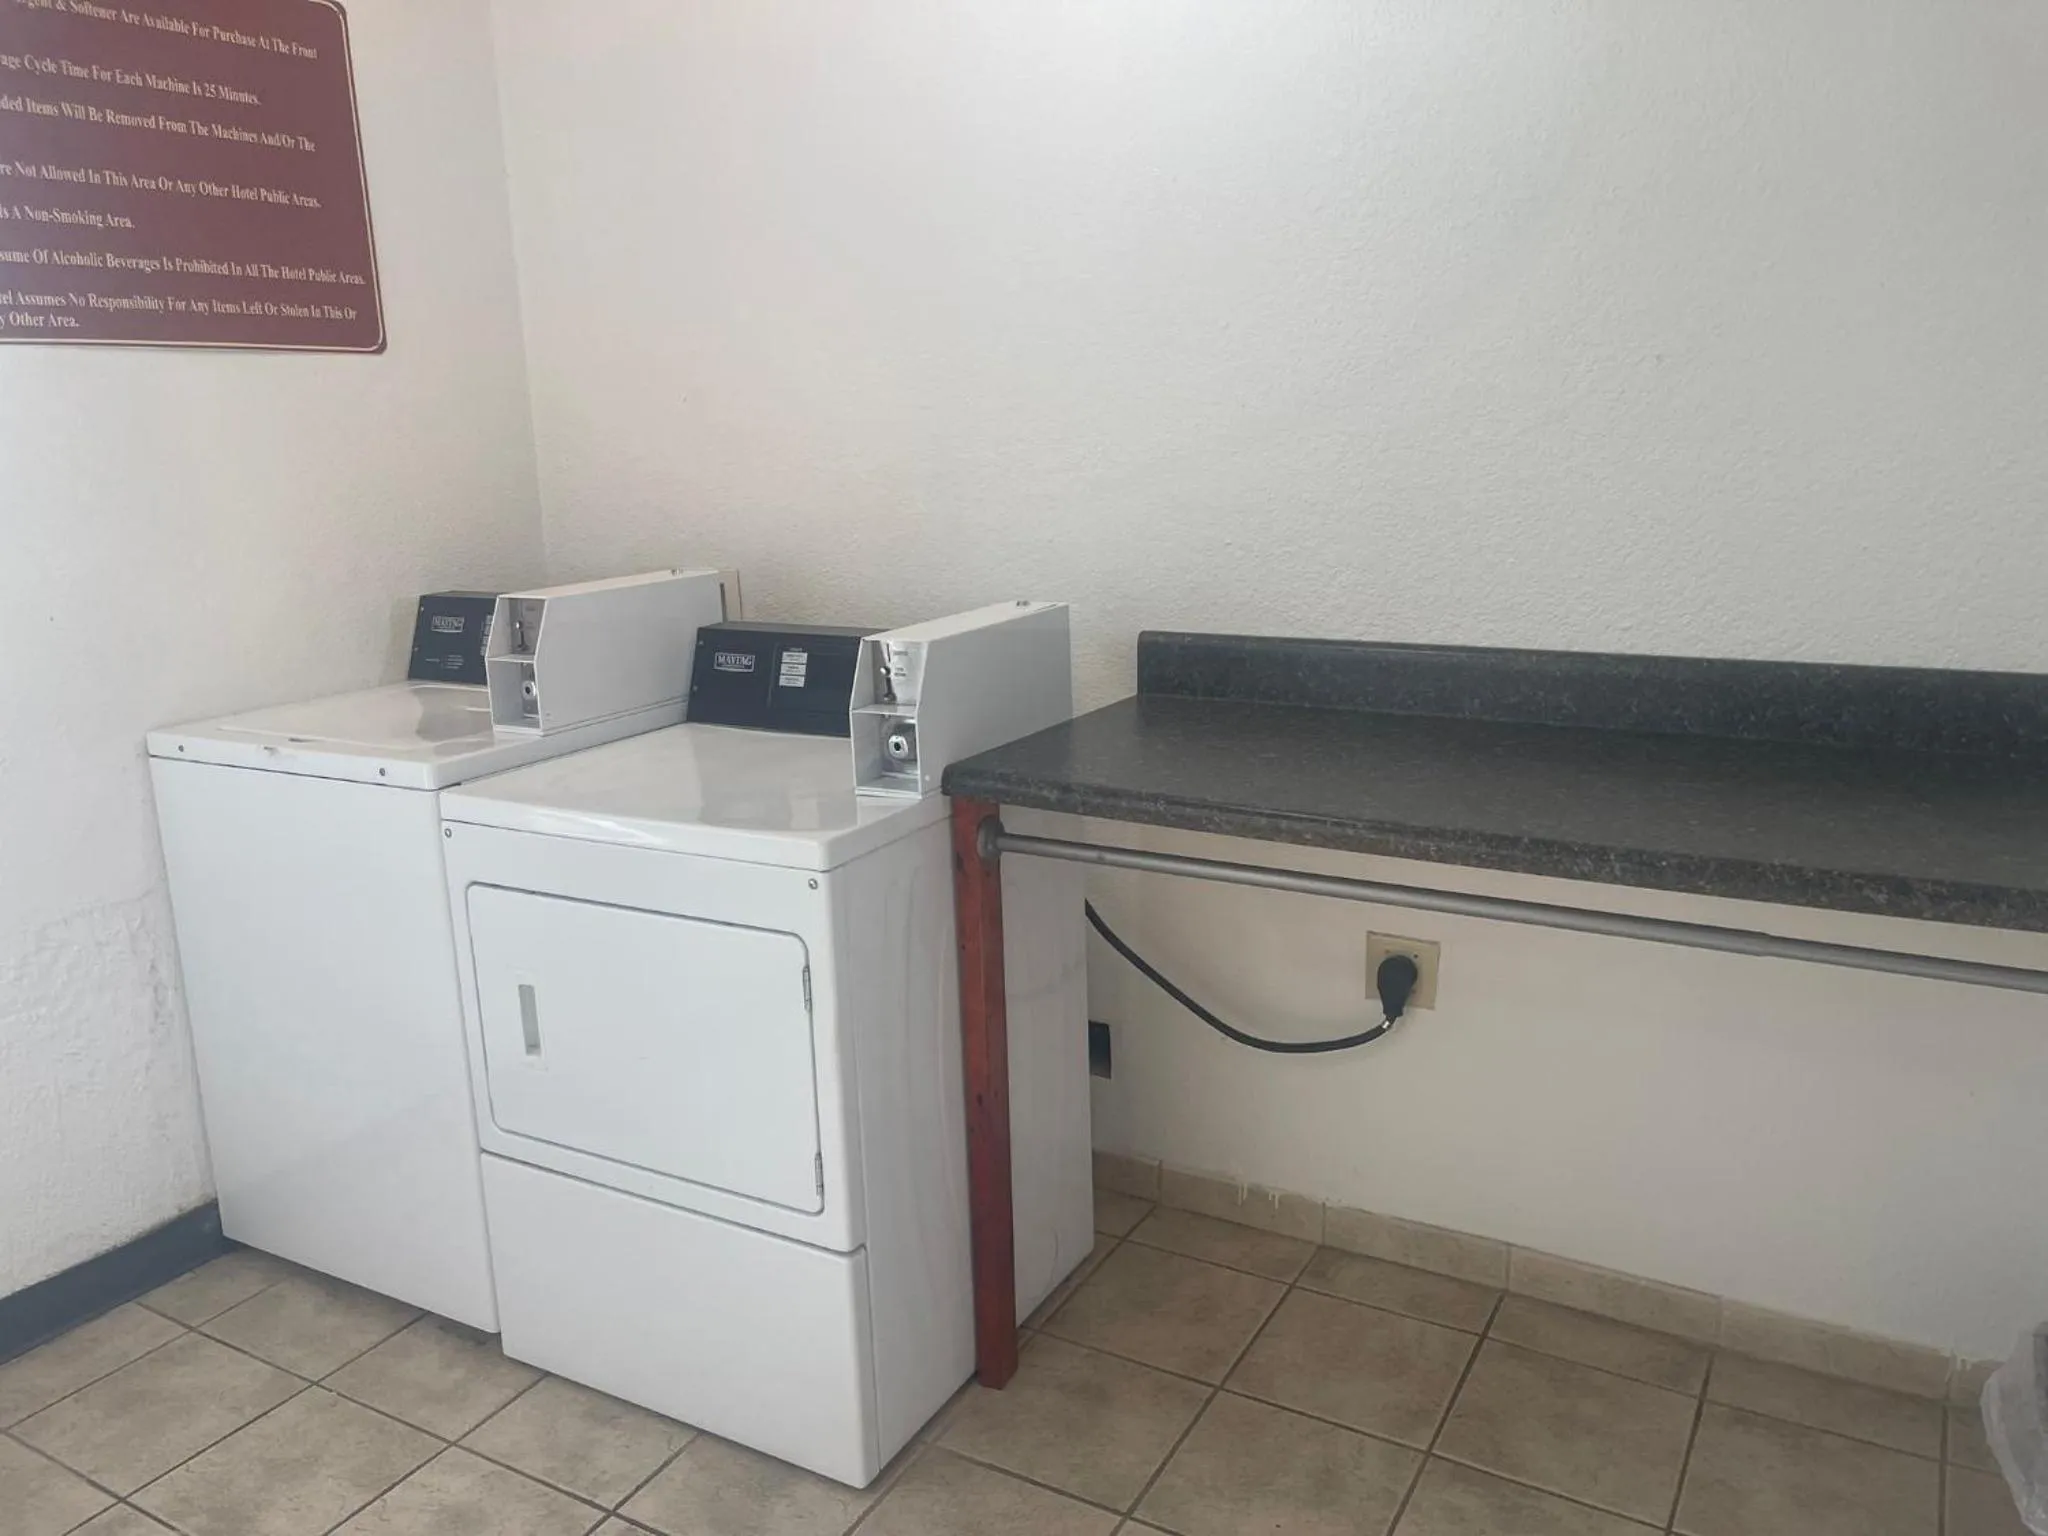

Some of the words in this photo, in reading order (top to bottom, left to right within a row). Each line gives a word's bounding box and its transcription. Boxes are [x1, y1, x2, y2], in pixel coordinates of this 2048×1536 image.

[55, 0, 68, 12] &
[69, 0, 117, 21] Softener
[120, 9, 140, 25] Are
[142, 13, 190, 34] Available
[192, 21, 210, 38] For
[212, 26, 256, 48] Purchase
[259, 35, 270, 50] At
[271, 37, 290, 54] The
[291, 41, 318, 59] Front
[24, 53, 58, 76] Cycle
[60, 59, 89, 79] Time
[92, 64, 112, 81] For
[114, 68, 143, 87] Each
[145, 72, 190, 95] Machine
[192, 80, 202, 97] Is
[204, 82, 216, 98] 25
[218, 84, 262, 106] Minutes.
[25, 97, 59, 117] Items
[60, 101, 86, 121] Will
[87, 105, 103, 122] Be
[105, 108, 156, 130] Removed
[158, 115, 187, 134] From
[187, 119, 209, 137] The
[211, 122, 258, 143] Machines
[260, 131, 296, 150] And/Or
[297, 135, 316, 152] The
[14, 160, 37, 179] Not
[41, 164, 86, 183] Allowed
[88, 168, 101, 185] In
[102, 169, 128, 188] This
[131, 173, 157, 191] Area
[159, 176, 174, 193] Or
[176, 179, 197, 198] Any
[199, 181, 229, 198] Other
[231, 184, 259, 202] Hotel
[260, 187, 291, 206] Public
[292, 192, 323, 209] Areas.
[12, 204, 22, 221] A
[24, 205, 104, 229] Non-Smoking
[105, 212, 136, 229] Area.
[33, 248, 49, 266] Of
[51, 249, 104, 269] Alcoholic
[106, 252, 161, 275] Beverages
[163, 255, 174, 272] Is
[175, 257, 230, 277] Prohibited
[231, 261, 243, 277] In
[245, 263, 260, 278] All
[260, 263, 280, 280] The
[281, 265, 307, 282] Hotel
[308, 267, 339, 284] Public
[339, 270, 367, 286] Areas.
[9, 310, 45, 328] Other
[48, 312, 81, 329] Area.
[15, 290, 67, 307] Assumes
[68, 291, 86, 308] No
[87, 291, 165, 315] Responsibility
[167, 295, 187, 312] For
[190, 298, 210, 316] Any
[212, 298, 241, 315] Items
[242, 300, 264, 316] Left
[264, 302, 280, 317] Or
[280, 303, 311, 318] Stolen
[311, 304, 322, 319] In
[322, 305, 343, 320] This
[343, 306, 359, 322] Or
[717, 654, 752, 667] MAYTAG
